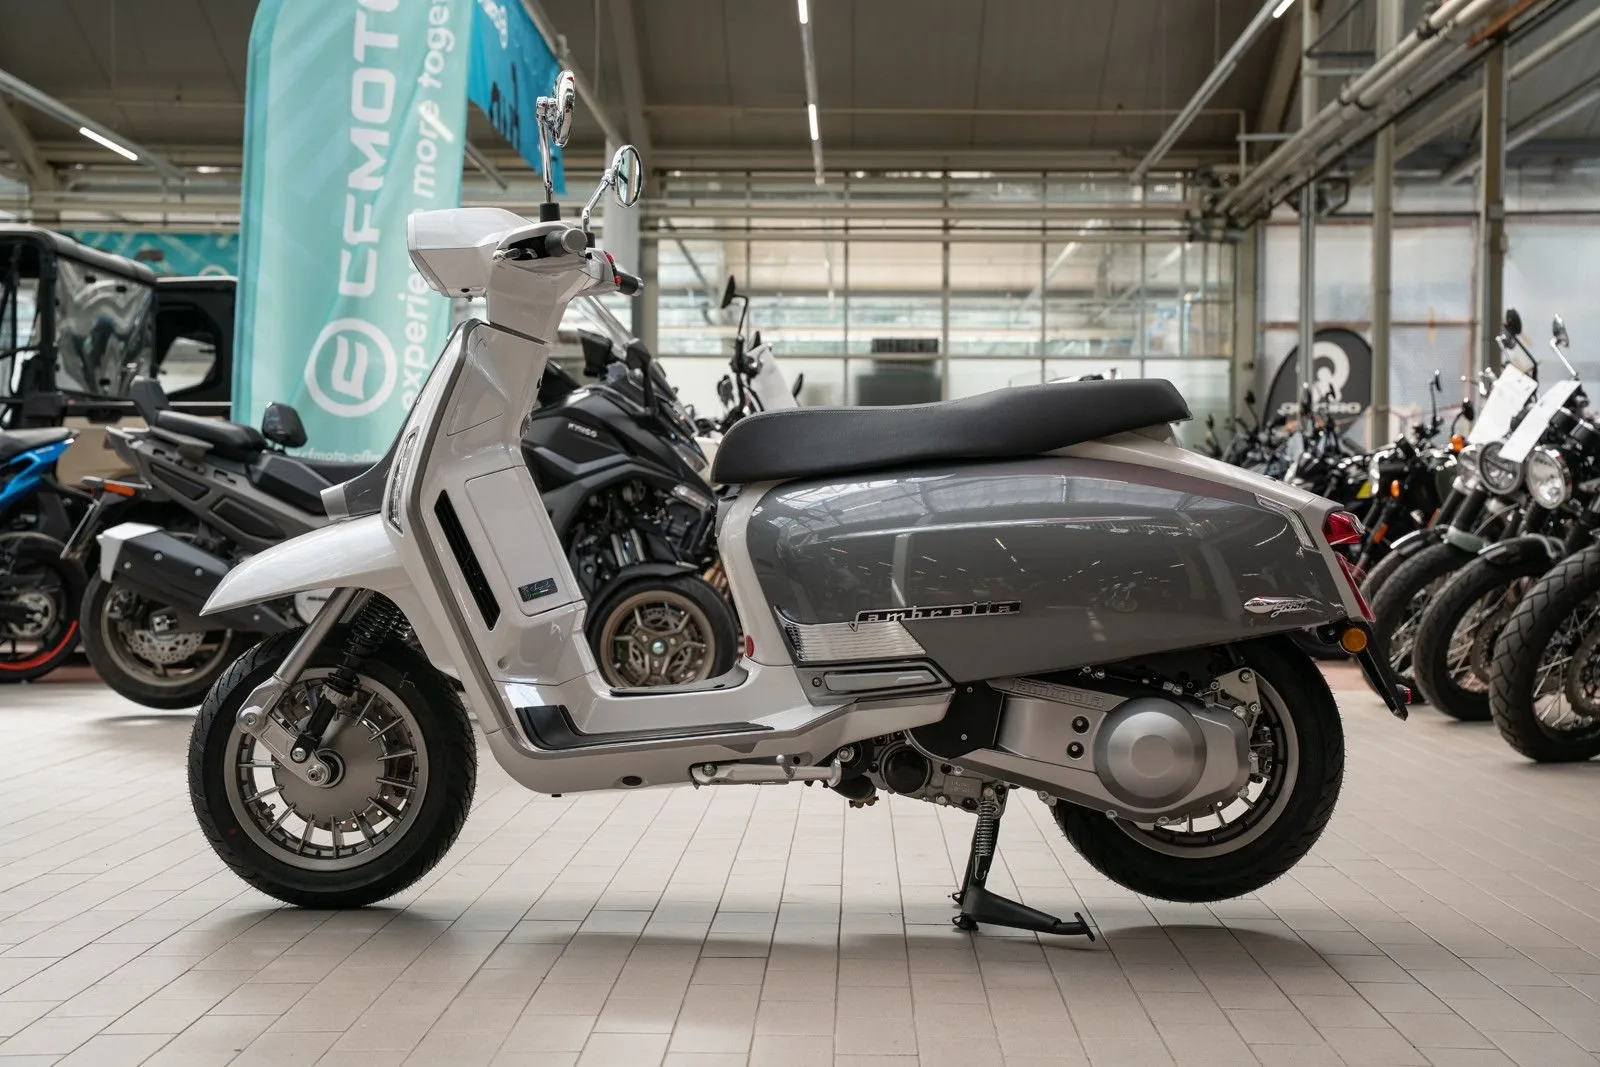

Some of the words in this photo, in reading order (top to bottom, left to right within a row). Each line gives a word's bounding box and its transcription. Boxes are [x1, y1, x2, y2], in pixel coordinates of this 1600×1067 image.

[417, 0, 455, 89] toge
[338, 0, 399, 297] CFMOT
[413, 99, 440, 199] more
